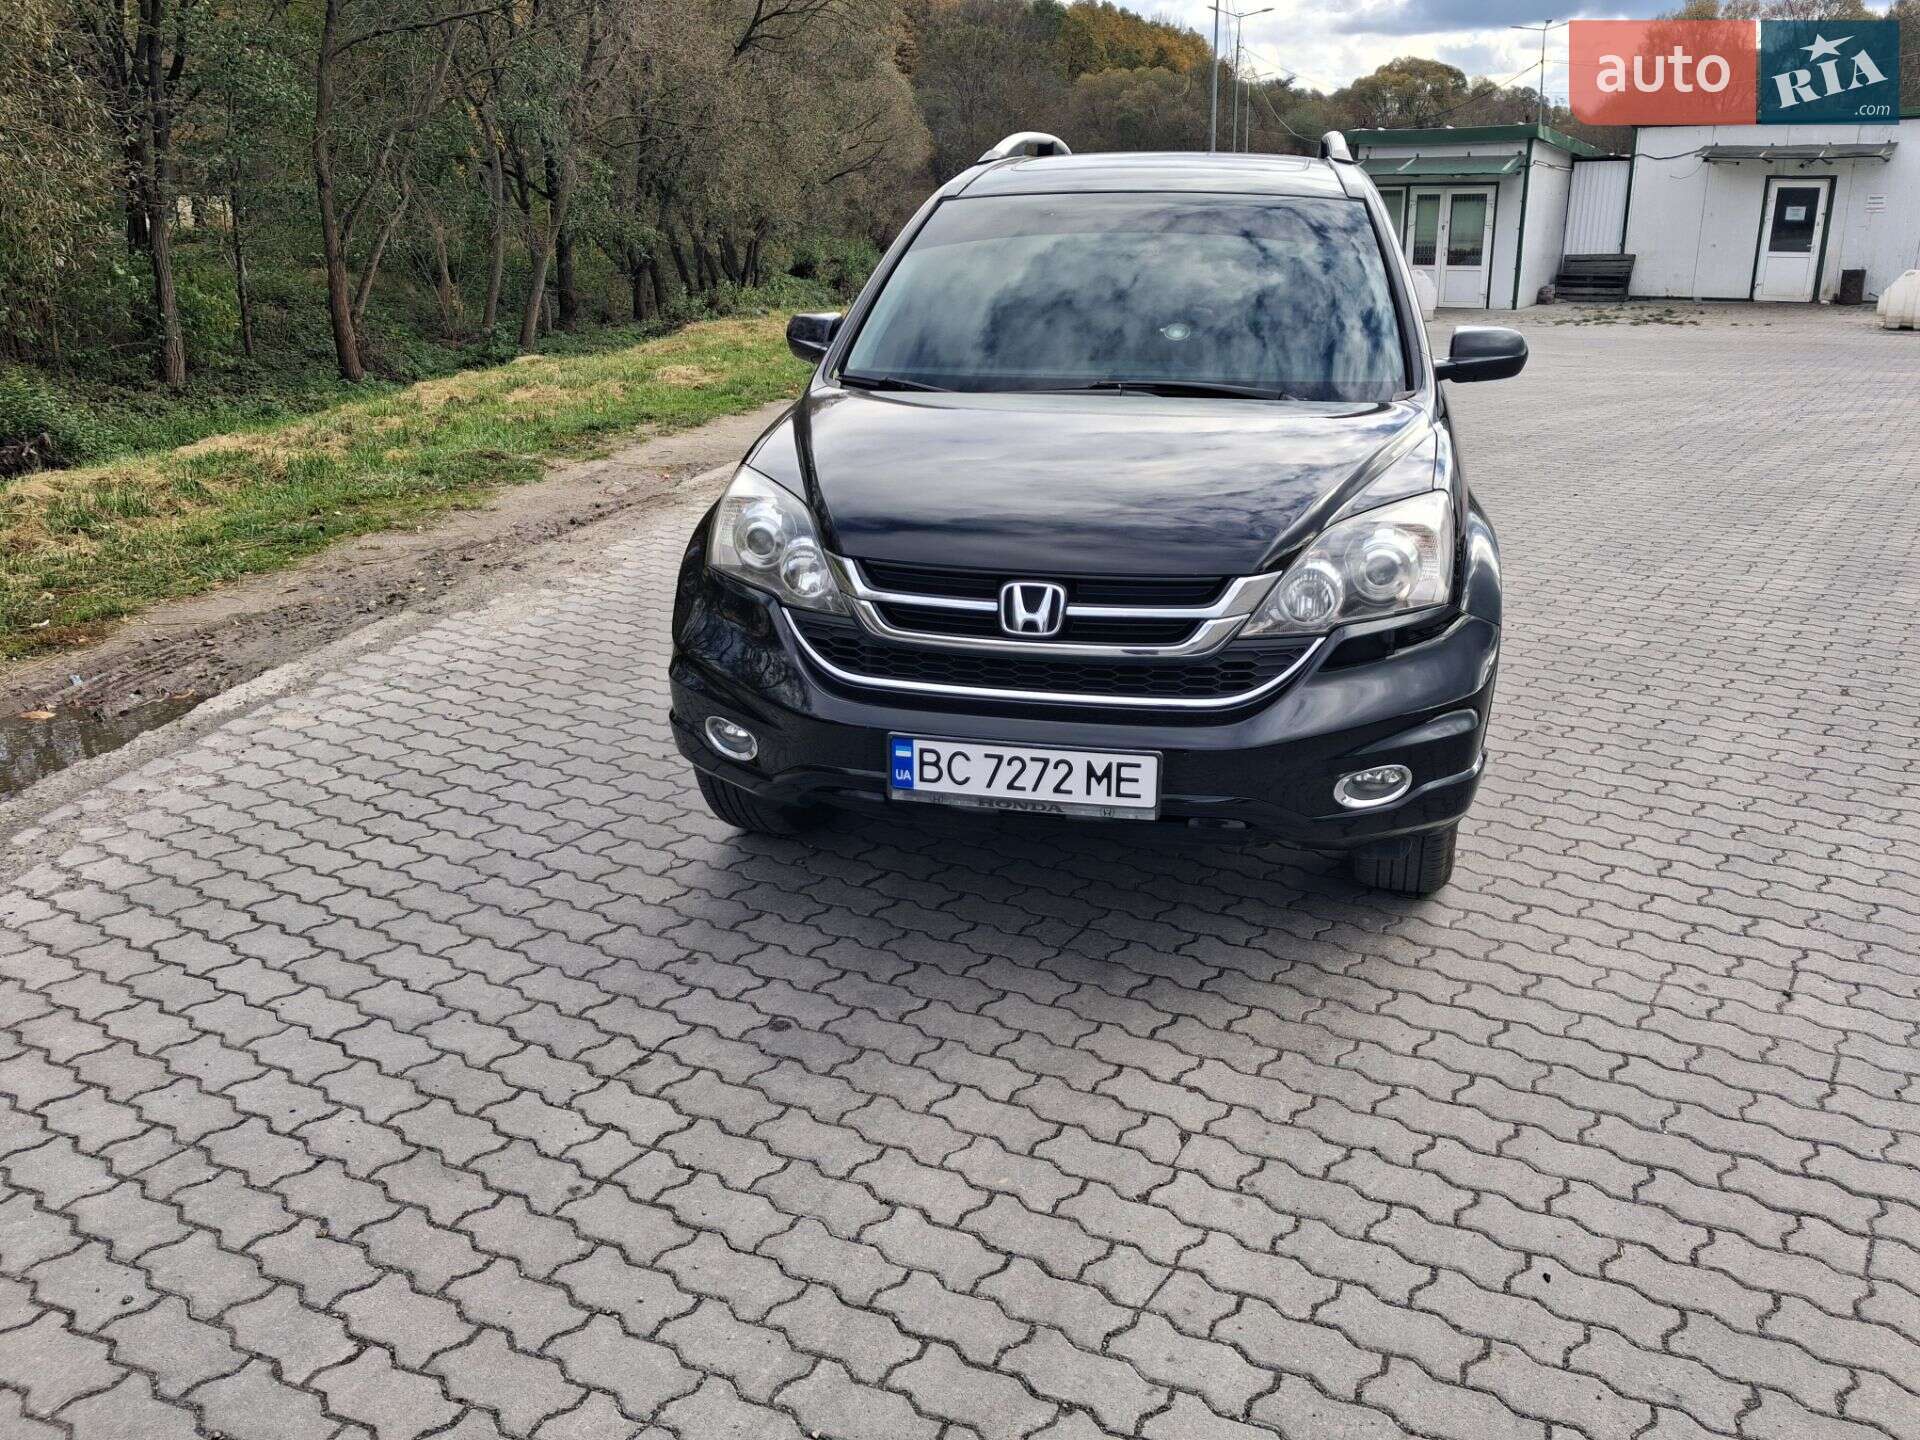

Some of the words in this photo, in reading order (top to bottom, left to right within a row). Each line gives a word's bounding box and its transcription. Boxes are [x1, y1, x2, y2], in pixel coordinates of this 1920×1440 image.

[895, 768, 912, 781] UA
[919, 747, 971, 785] BC
[984, 753, 1074, 794] 7272
[1085, 760, 1142, 799] ME
[978, 798, 1064, 813] HONDA
